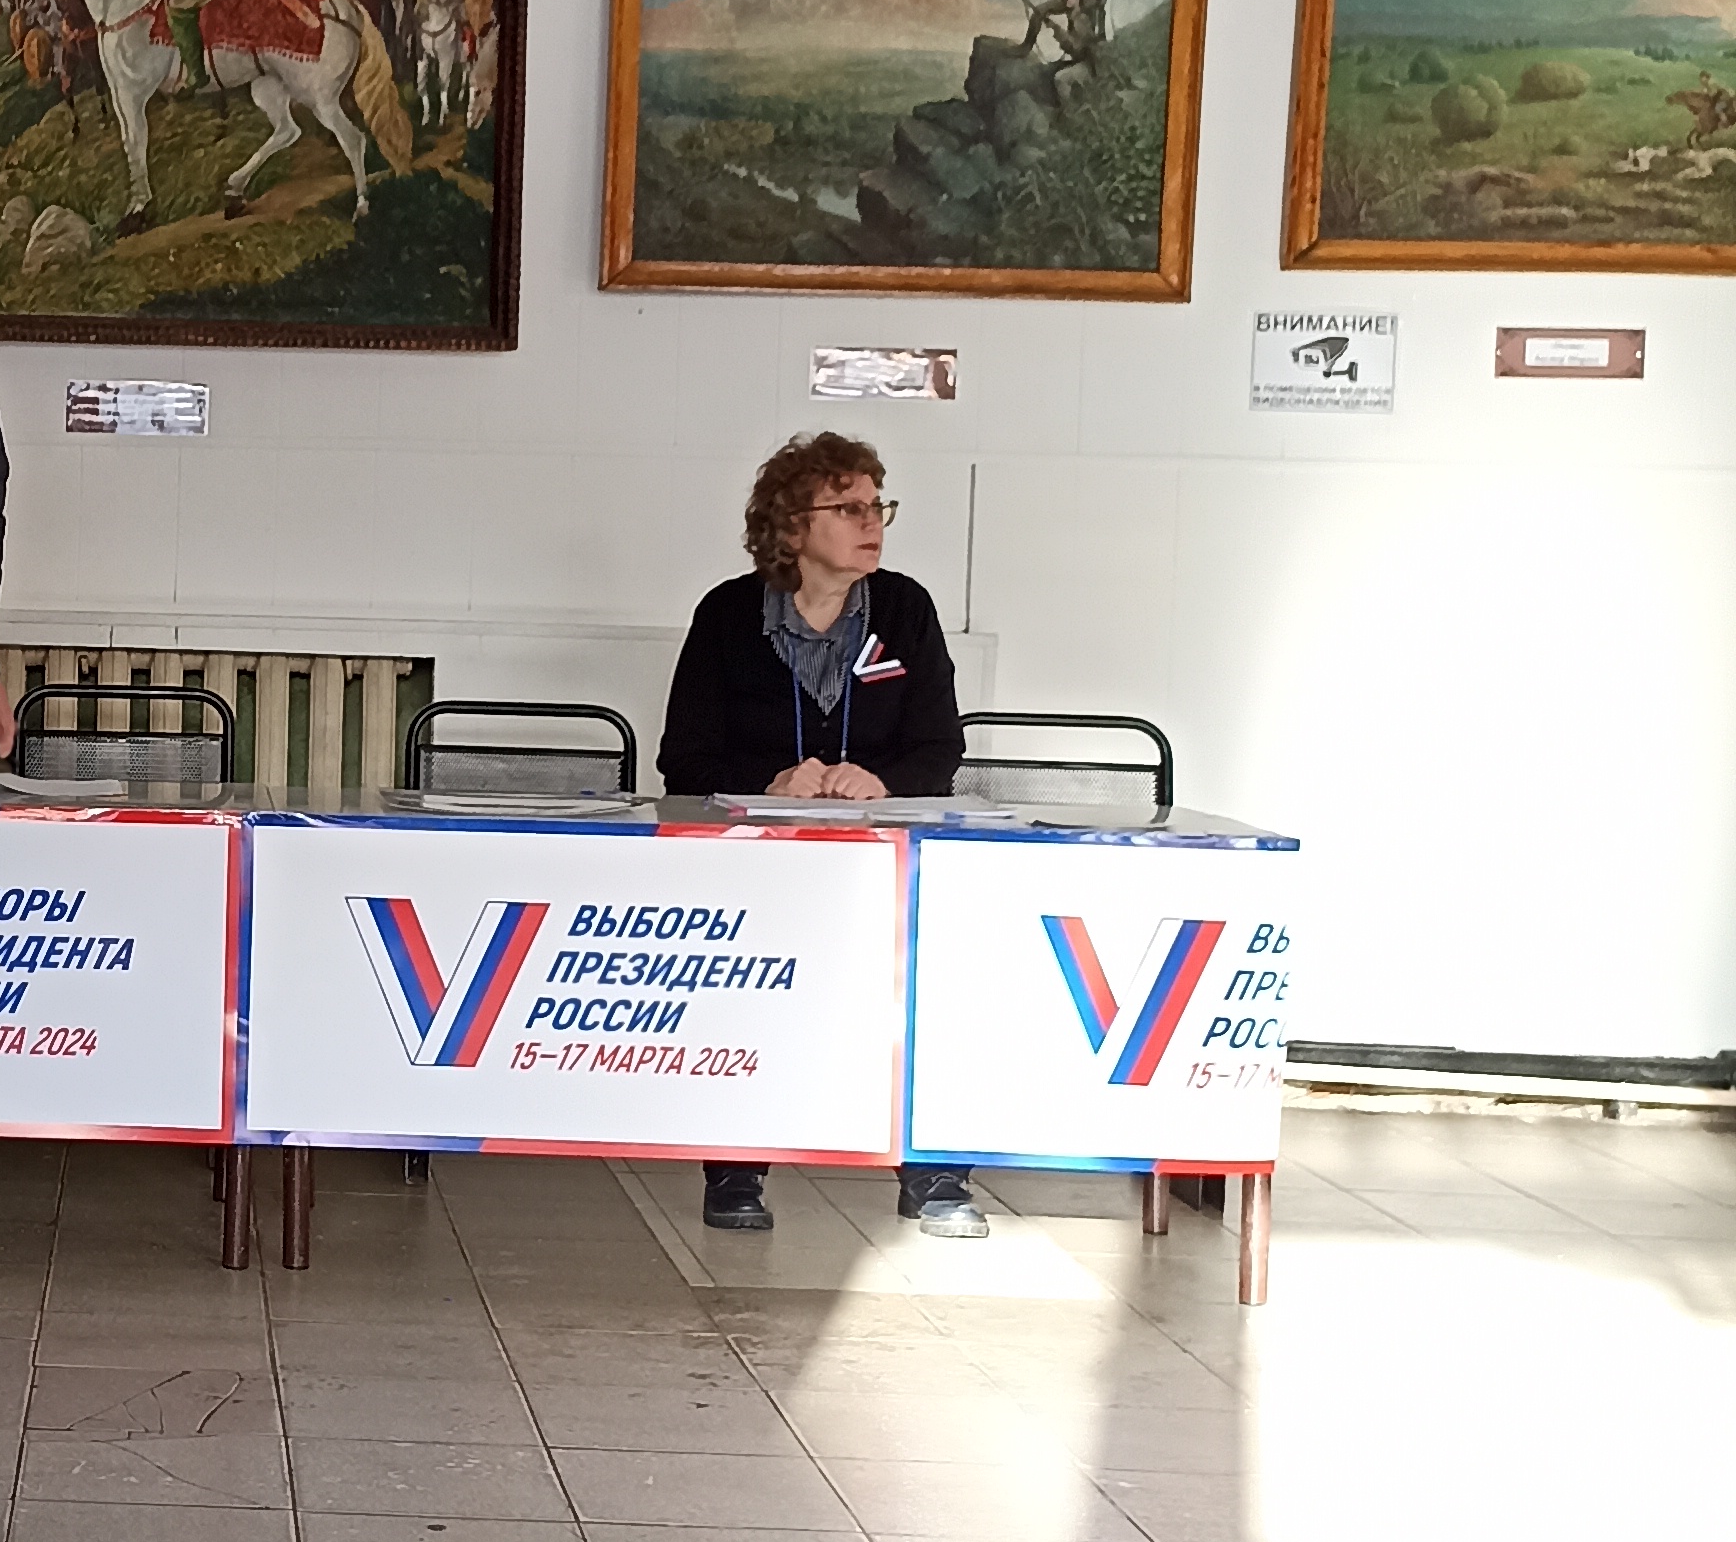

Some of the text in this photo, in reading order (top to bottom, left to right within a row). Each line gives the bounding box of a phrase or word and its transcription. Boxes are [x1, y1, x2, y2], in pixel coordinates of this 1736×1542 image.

[567, 905, 747, 942] ВЫБОРЫ
[546, 951, 798, 992] ПРЕЗИДЕНТА
[525, 997, 688, 1035] РОССИИ
[29, 1027, 98, 1057] 2024
[592, 1045, 686, 1076] МАРТА
[689, 1047, 760, 1078] 2024
